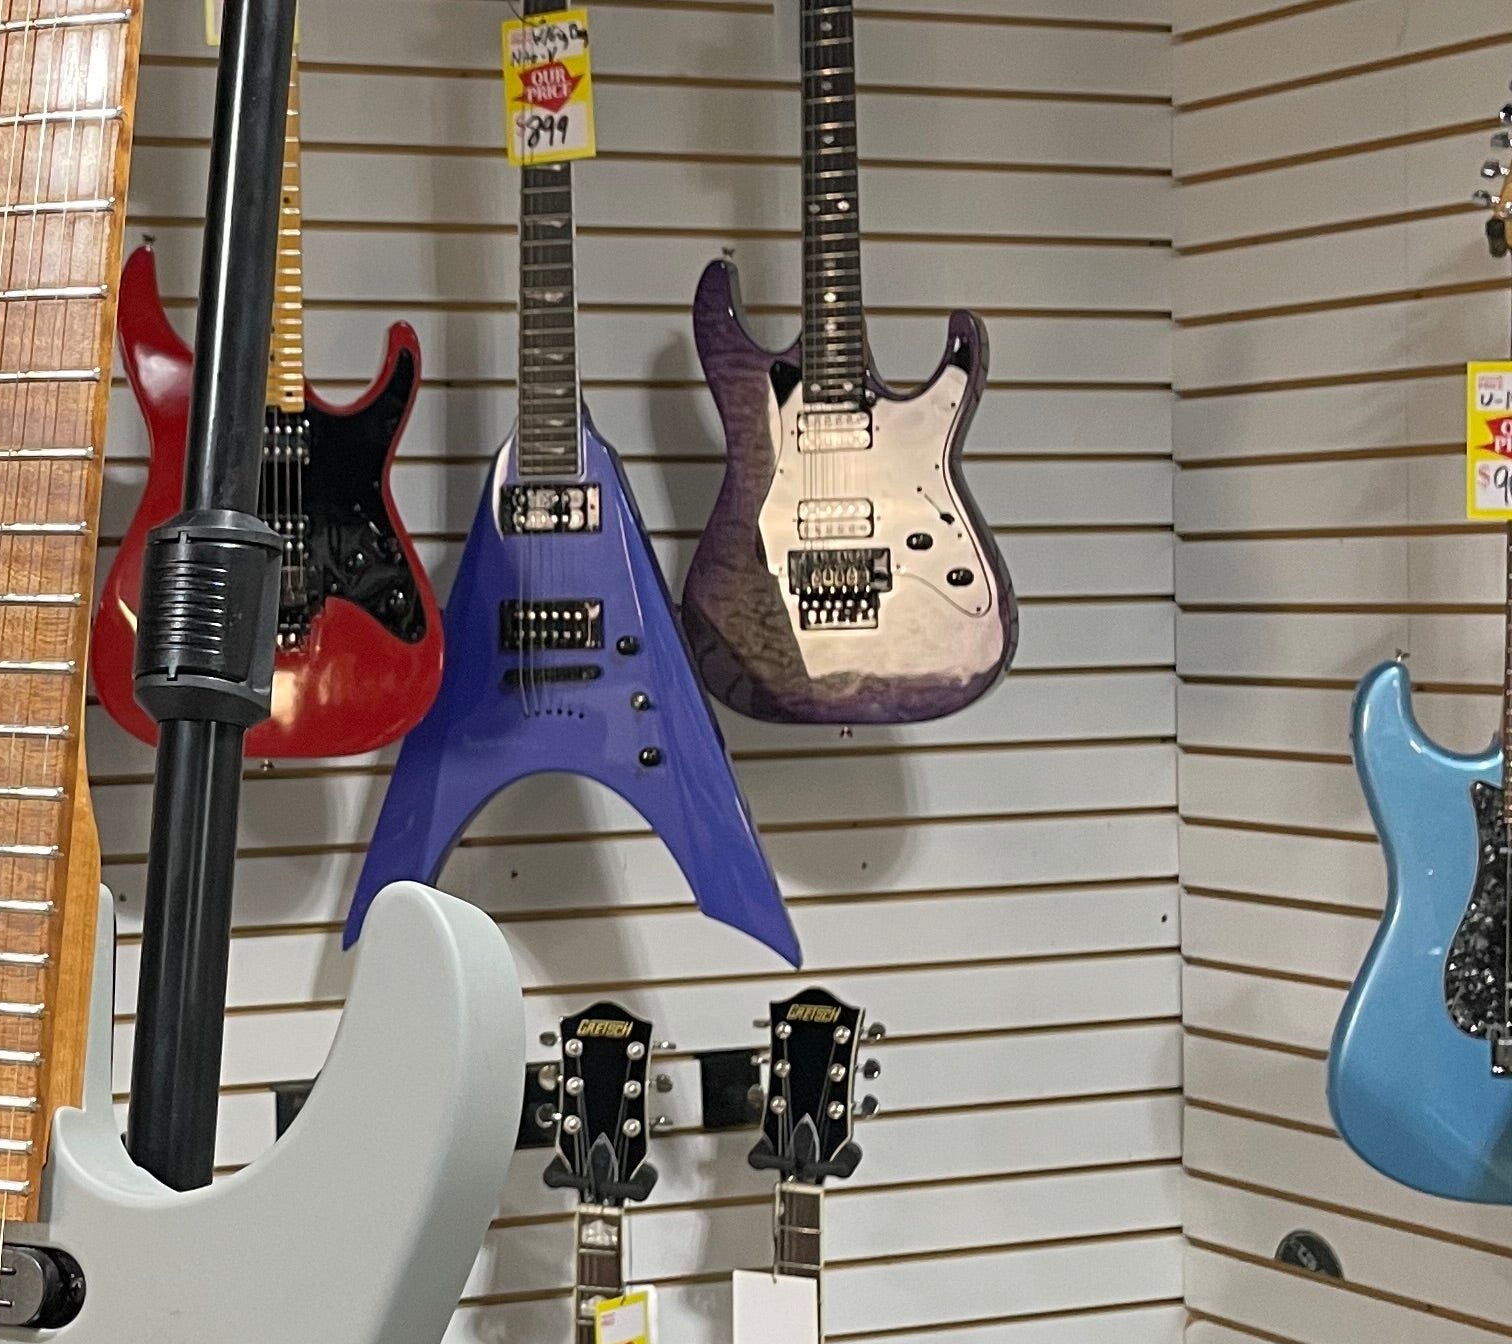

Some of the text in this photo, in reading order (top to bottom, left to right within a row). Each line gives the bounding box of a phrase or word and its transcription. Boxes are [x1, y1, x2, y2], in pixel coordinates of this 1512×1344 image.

[531, 67, 566, 85] OUR
[526, 81, 573, 103] PRICE
[1479, 464, 1512, 506] $9
[786, 1003, 841, 1024] GRETSCH
[576, 1018, 634, 1039] GRETSCH
